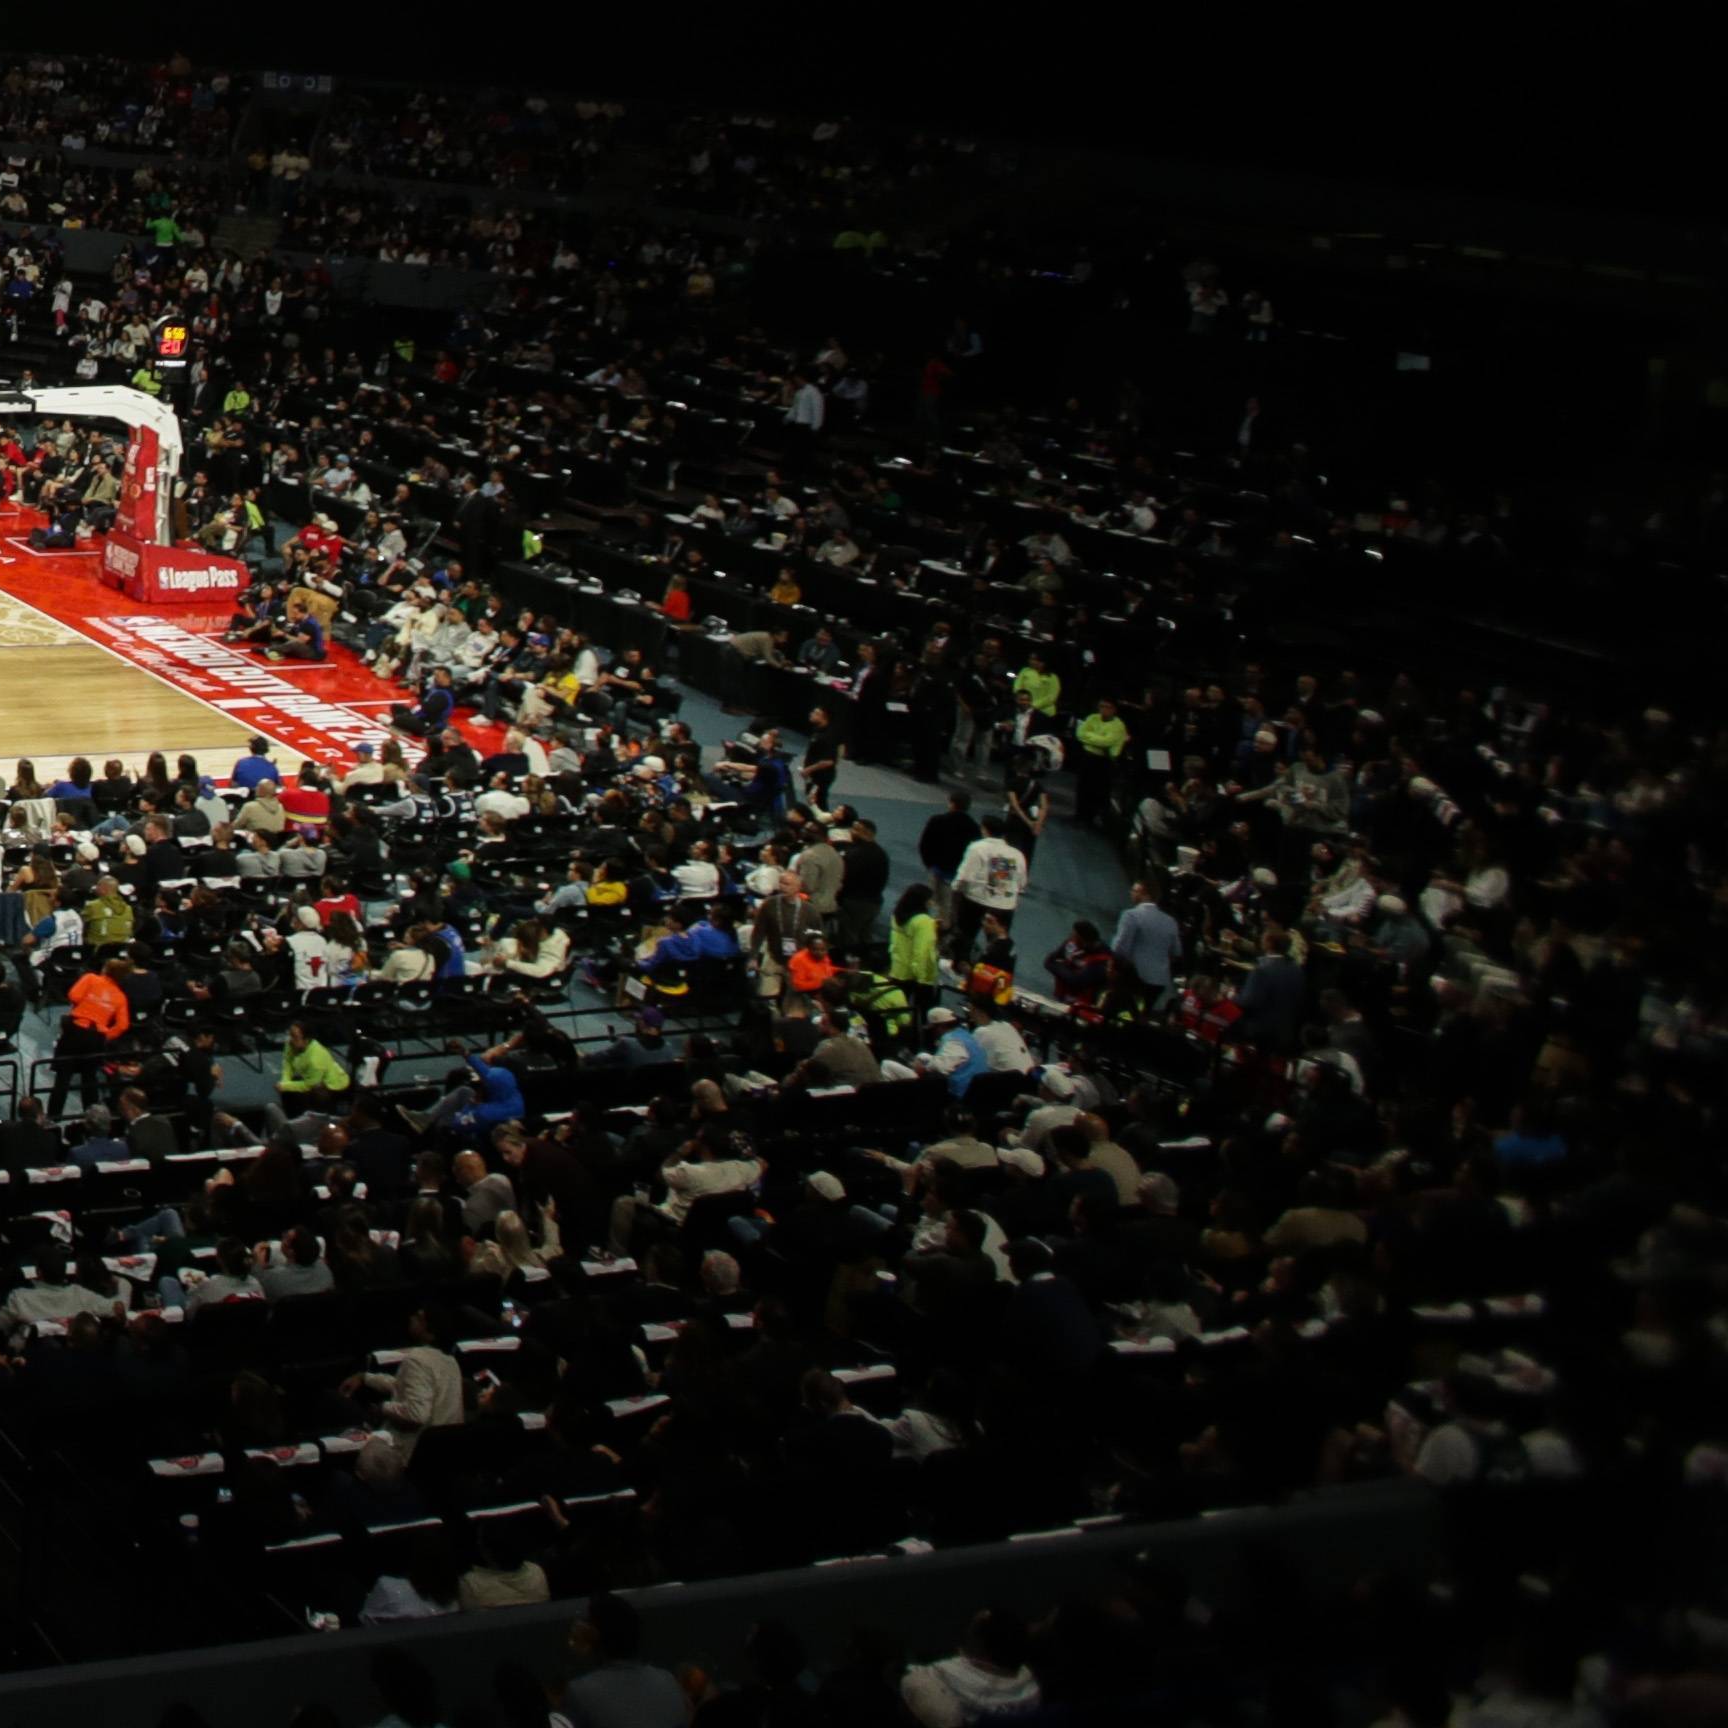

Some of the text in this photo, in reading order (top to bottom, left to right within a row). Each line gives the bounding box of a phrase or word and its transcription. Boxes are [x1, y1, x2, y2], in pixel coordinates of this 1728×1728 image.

[160, 338, 181, 355] 20
[169, 566, 239, 592] League Pass
[127, 626, 253, 668] MEXICO
